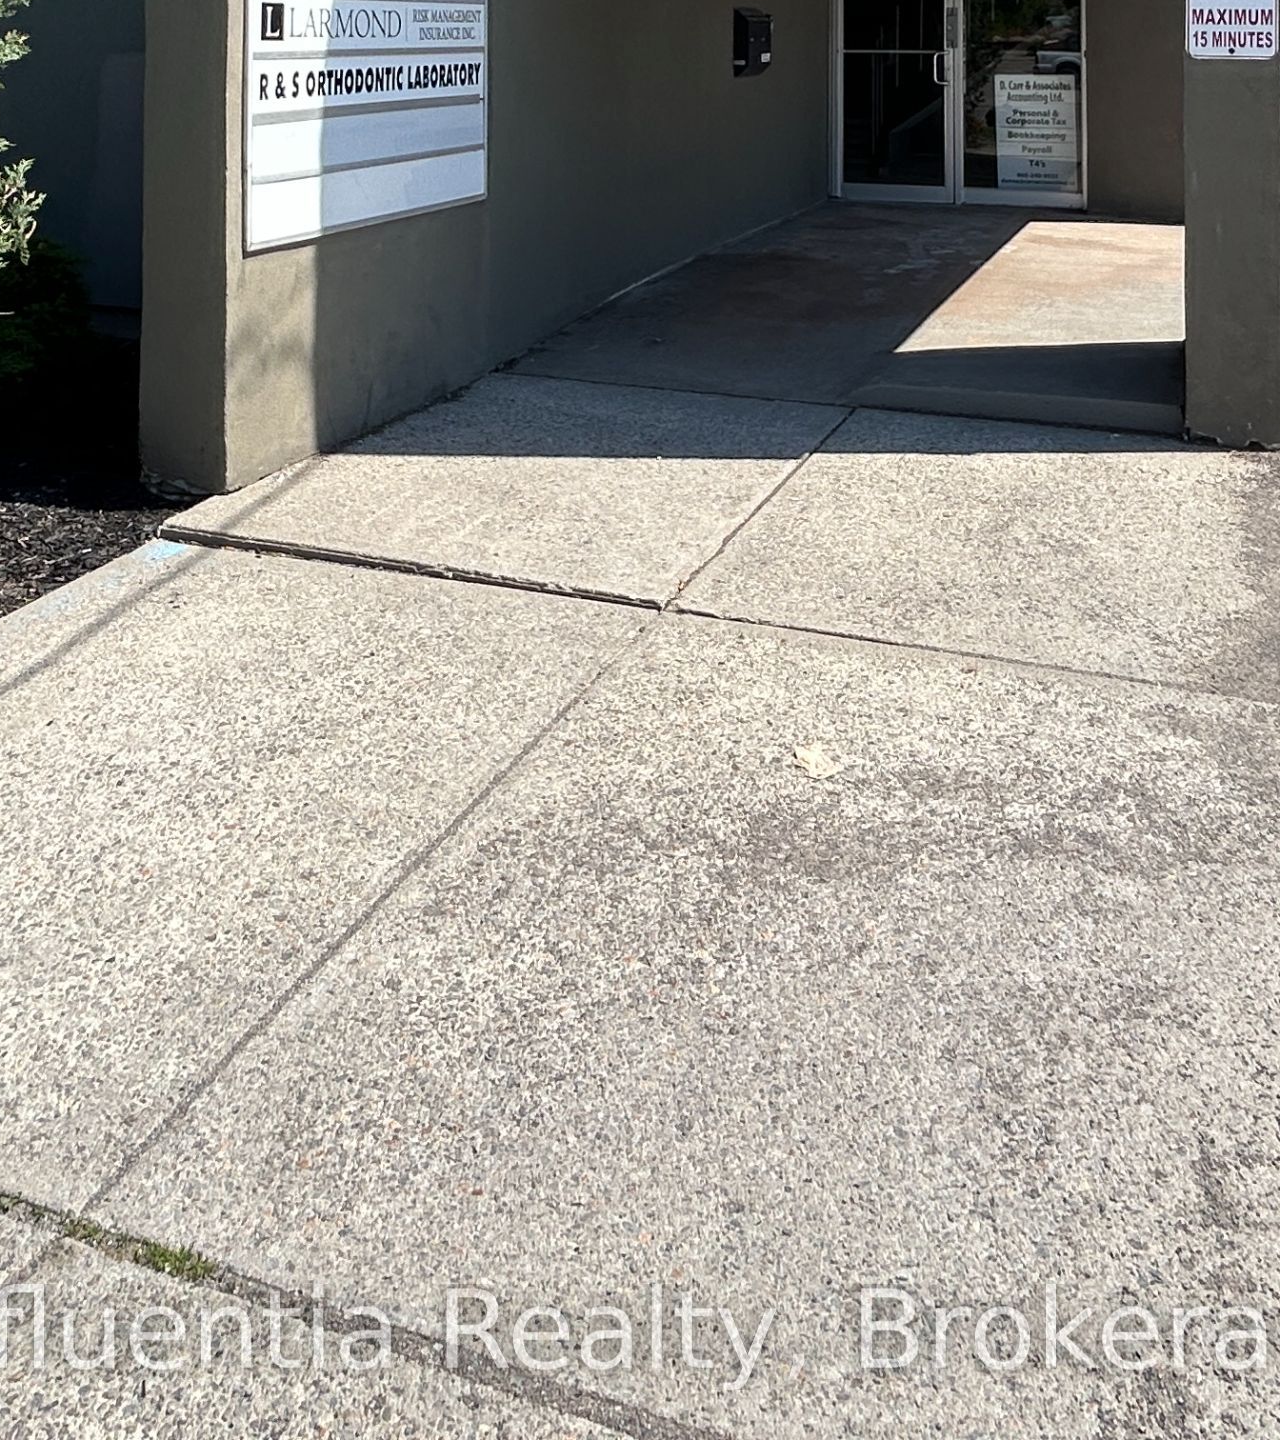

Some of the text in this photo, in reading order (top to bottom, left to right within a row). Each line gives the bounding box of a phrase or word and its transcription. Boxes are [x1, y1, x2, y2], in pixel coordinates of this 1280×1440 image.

[412, 9, 481, 23] RISK MANAGEMENT
[1191, 8, 1273, 26] MAXIMUM
[290, 7, 402, 39] LARMOND
[419, 27, 460, 40] INSURANCE
[1192, 31, 1273, 48] 15 MINUTES
[259, 62, 481, 101] R & S ORTHODONTIC LABORATORY
[1008, 80, 1024, 90] Carr
[1025, 81, 1030, 90] &
[1032, 80, 1072, 91] Associates
[1007, 92, 1064, 103] Accounting Ltd.
[1012, 109, 1051, 117] Personal
[1006, 117, 1050, 127] Corporate
[1007, 131, 1067, 141] Bookkeeping
[1021, 145, 1053, 154] Payroll
